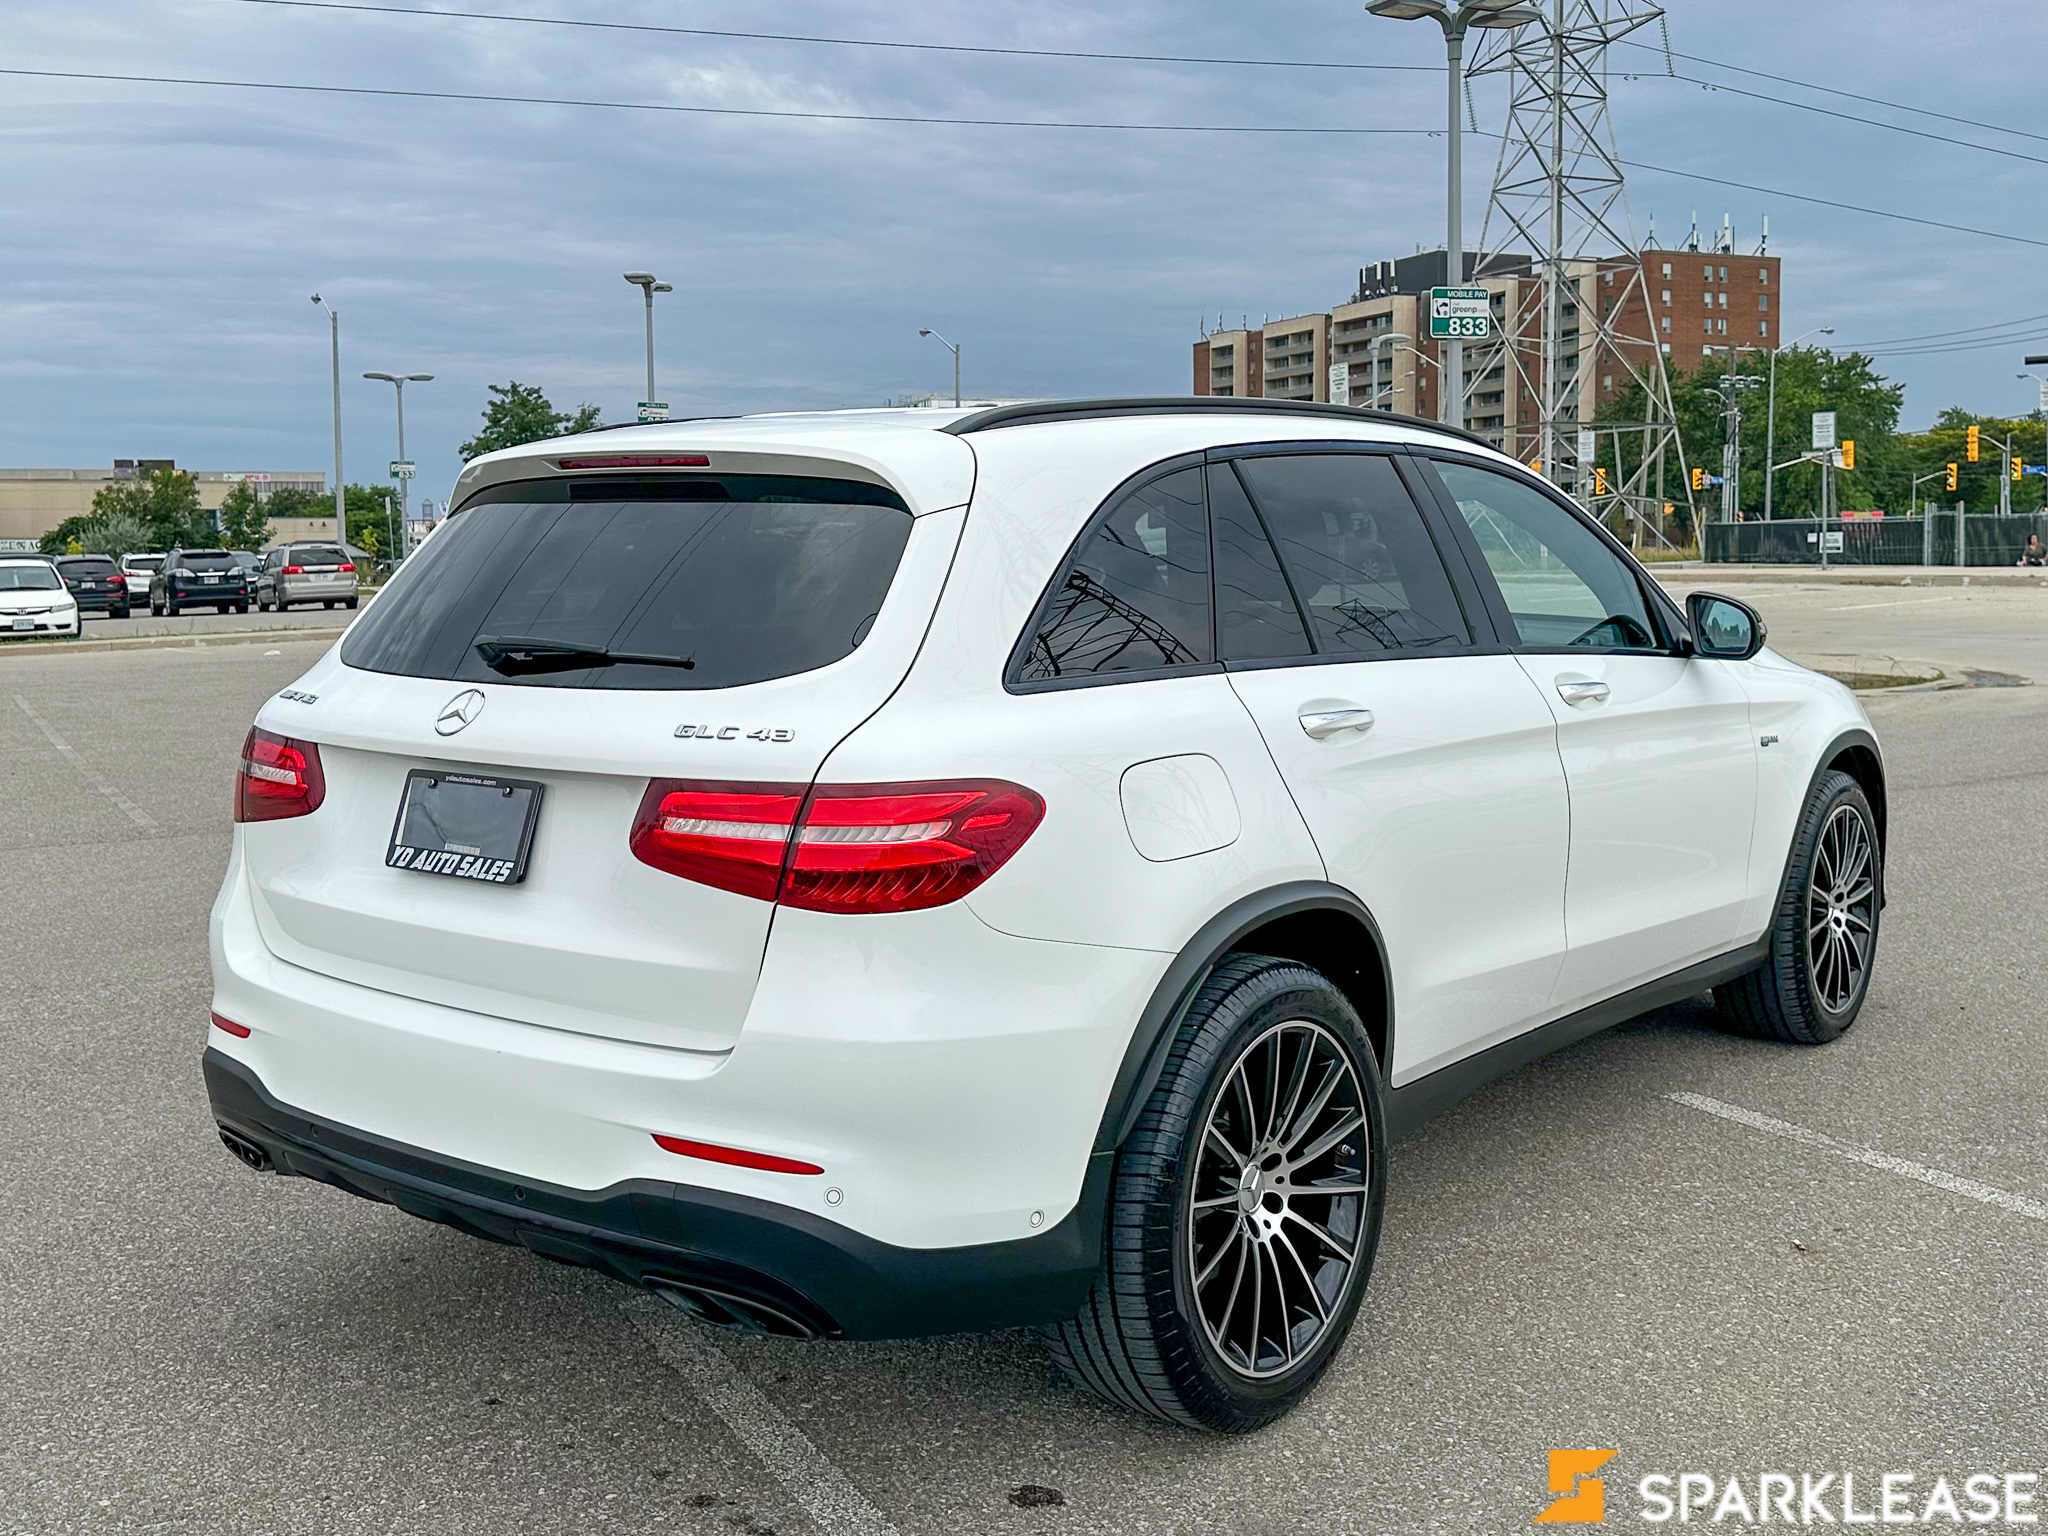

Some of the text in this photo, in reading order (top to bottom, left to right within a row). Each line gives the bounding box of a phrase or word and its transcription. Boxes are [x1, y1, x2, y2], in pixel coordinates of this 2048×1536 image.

[1447, 290, 1487, 299] MOBILE PAY
[1448, 317, 1487, 335] 833
[674, 724, 795, 742] GLC 43
[389, 846, 415, 867] YD
[409, 849, 461, 874] AUTO
[456, 855, 515, 882] SALES
